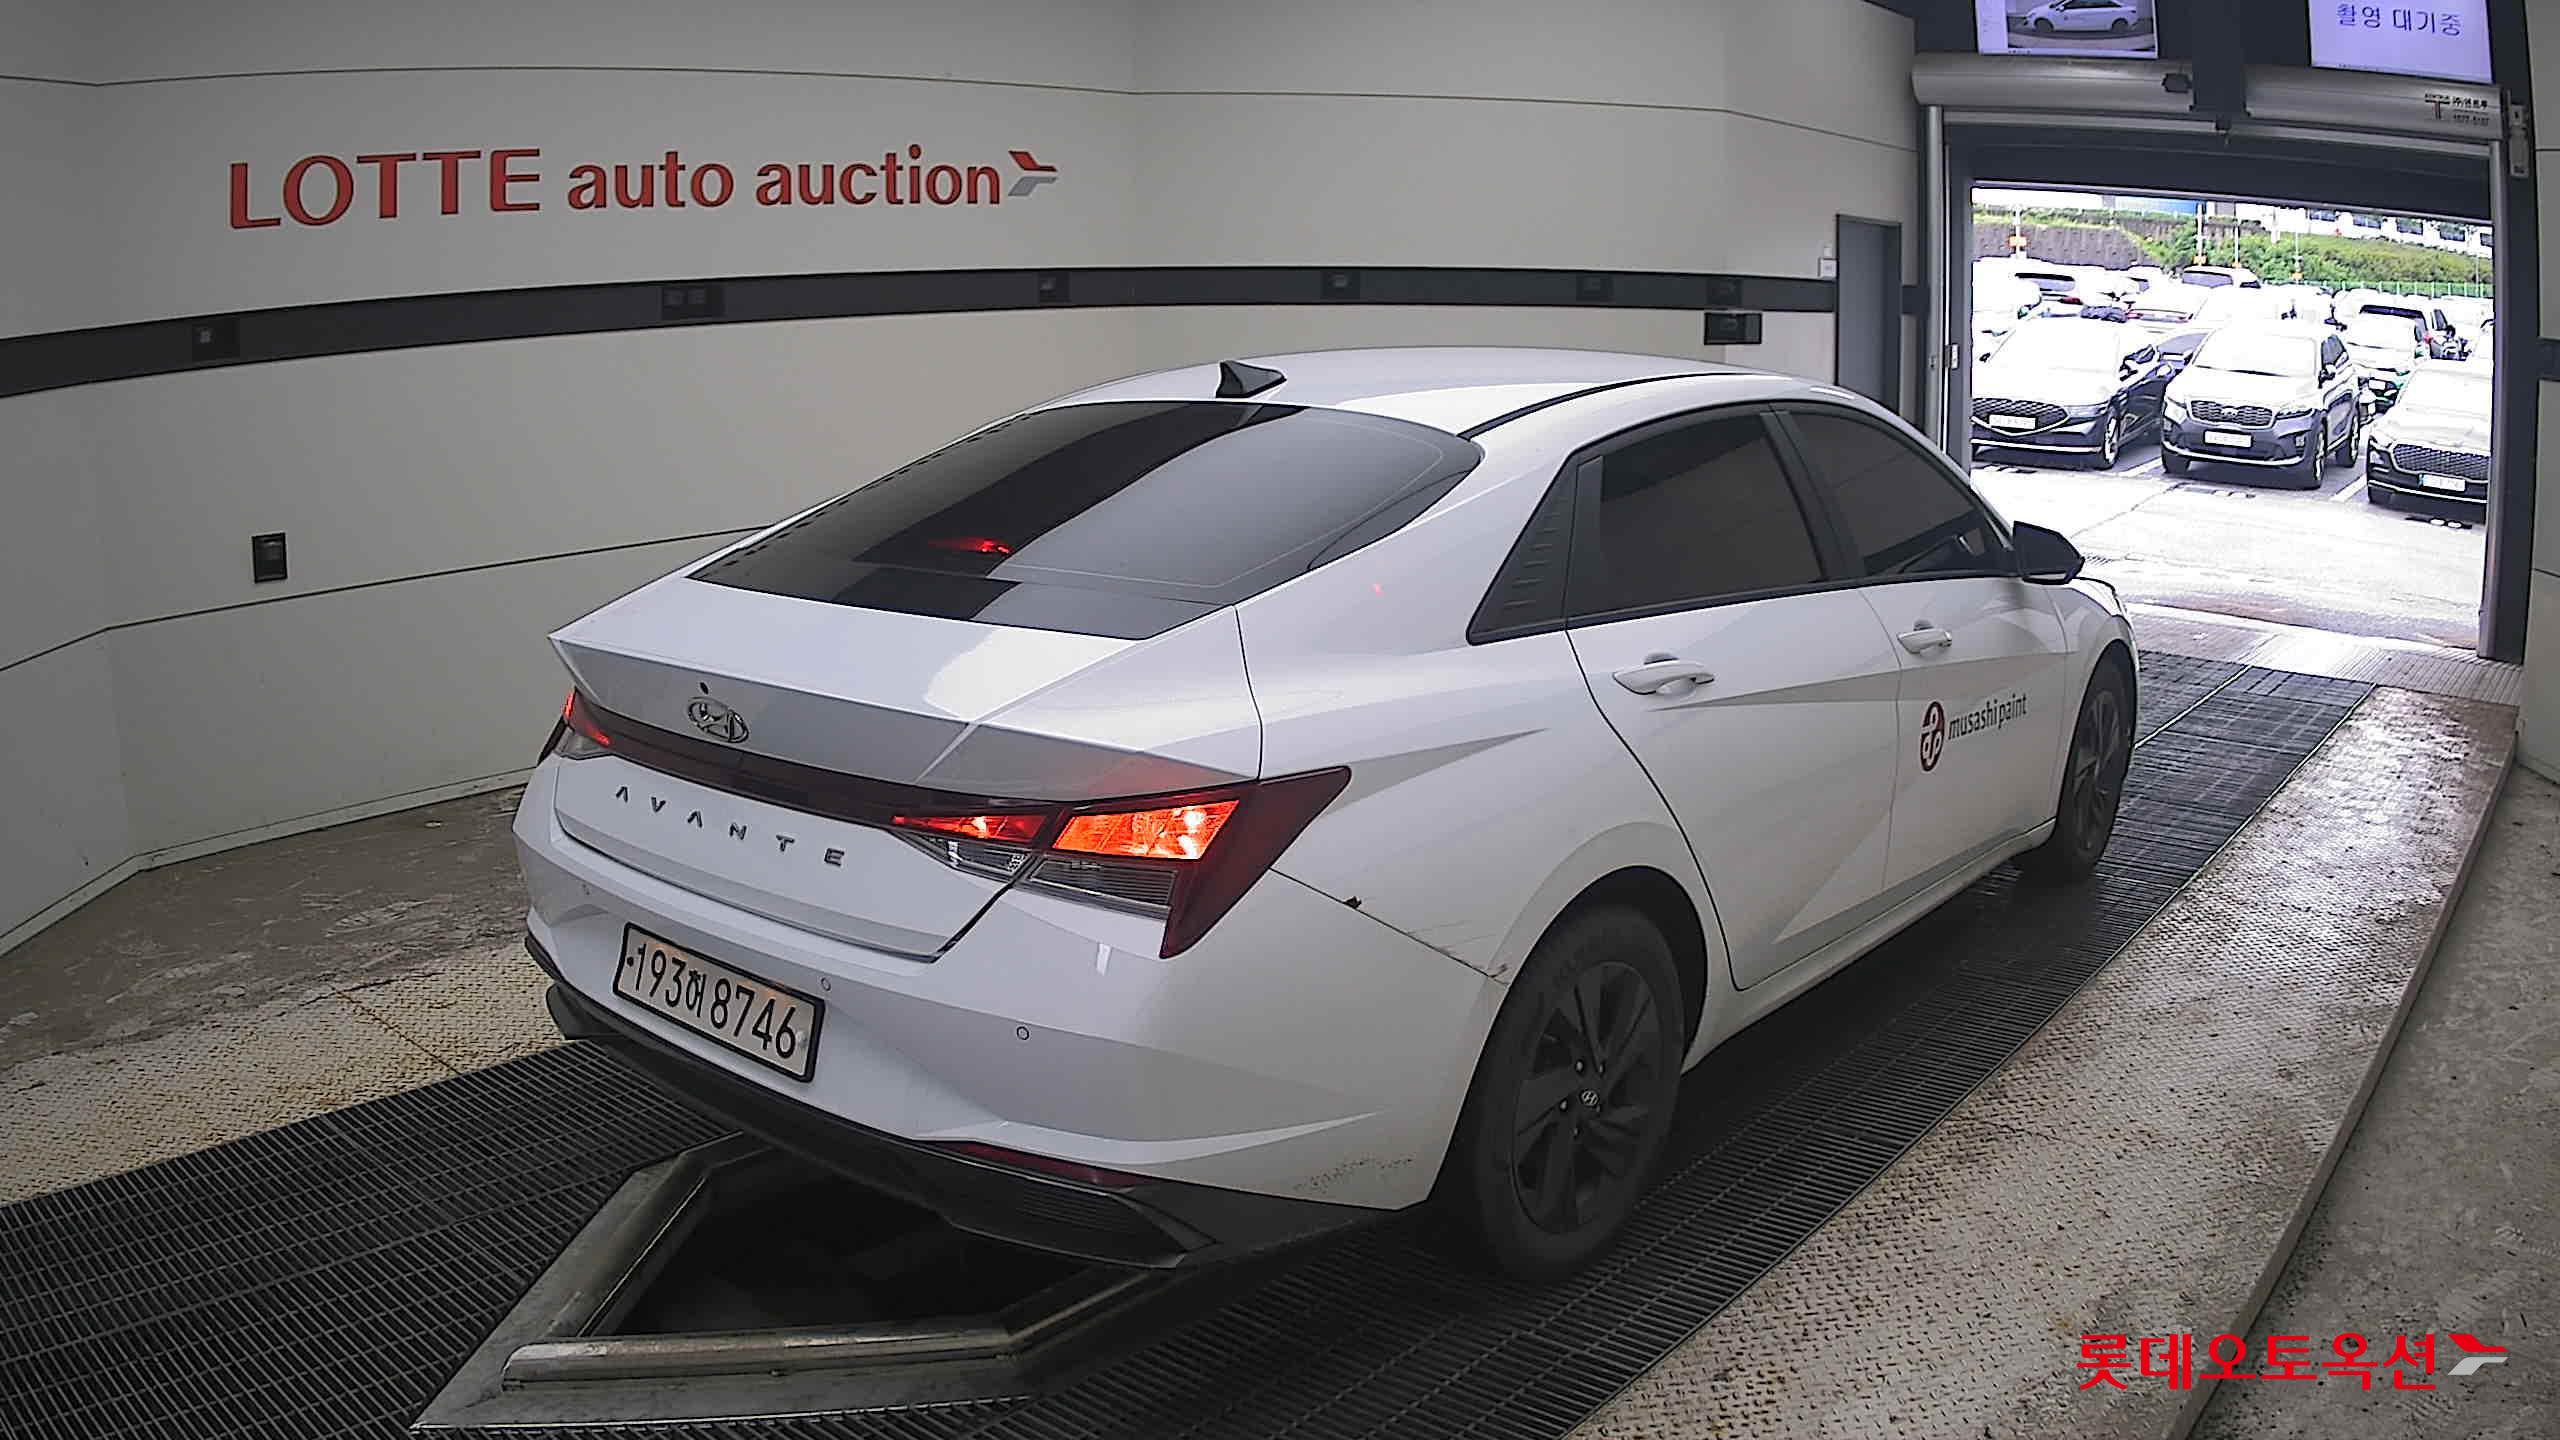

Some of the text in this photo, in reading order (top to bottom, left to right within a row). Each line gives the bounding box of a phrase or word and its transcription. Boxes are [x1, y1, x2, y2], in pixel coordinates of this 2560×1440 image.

[2336, 3, 2462, 37] 촬영 대기중
[229, 144, 1000, 229] LOTTE auto auction
[1948, 692, 2027, 740] musashi paint
[615, 785, 846, 867] AVANTE
